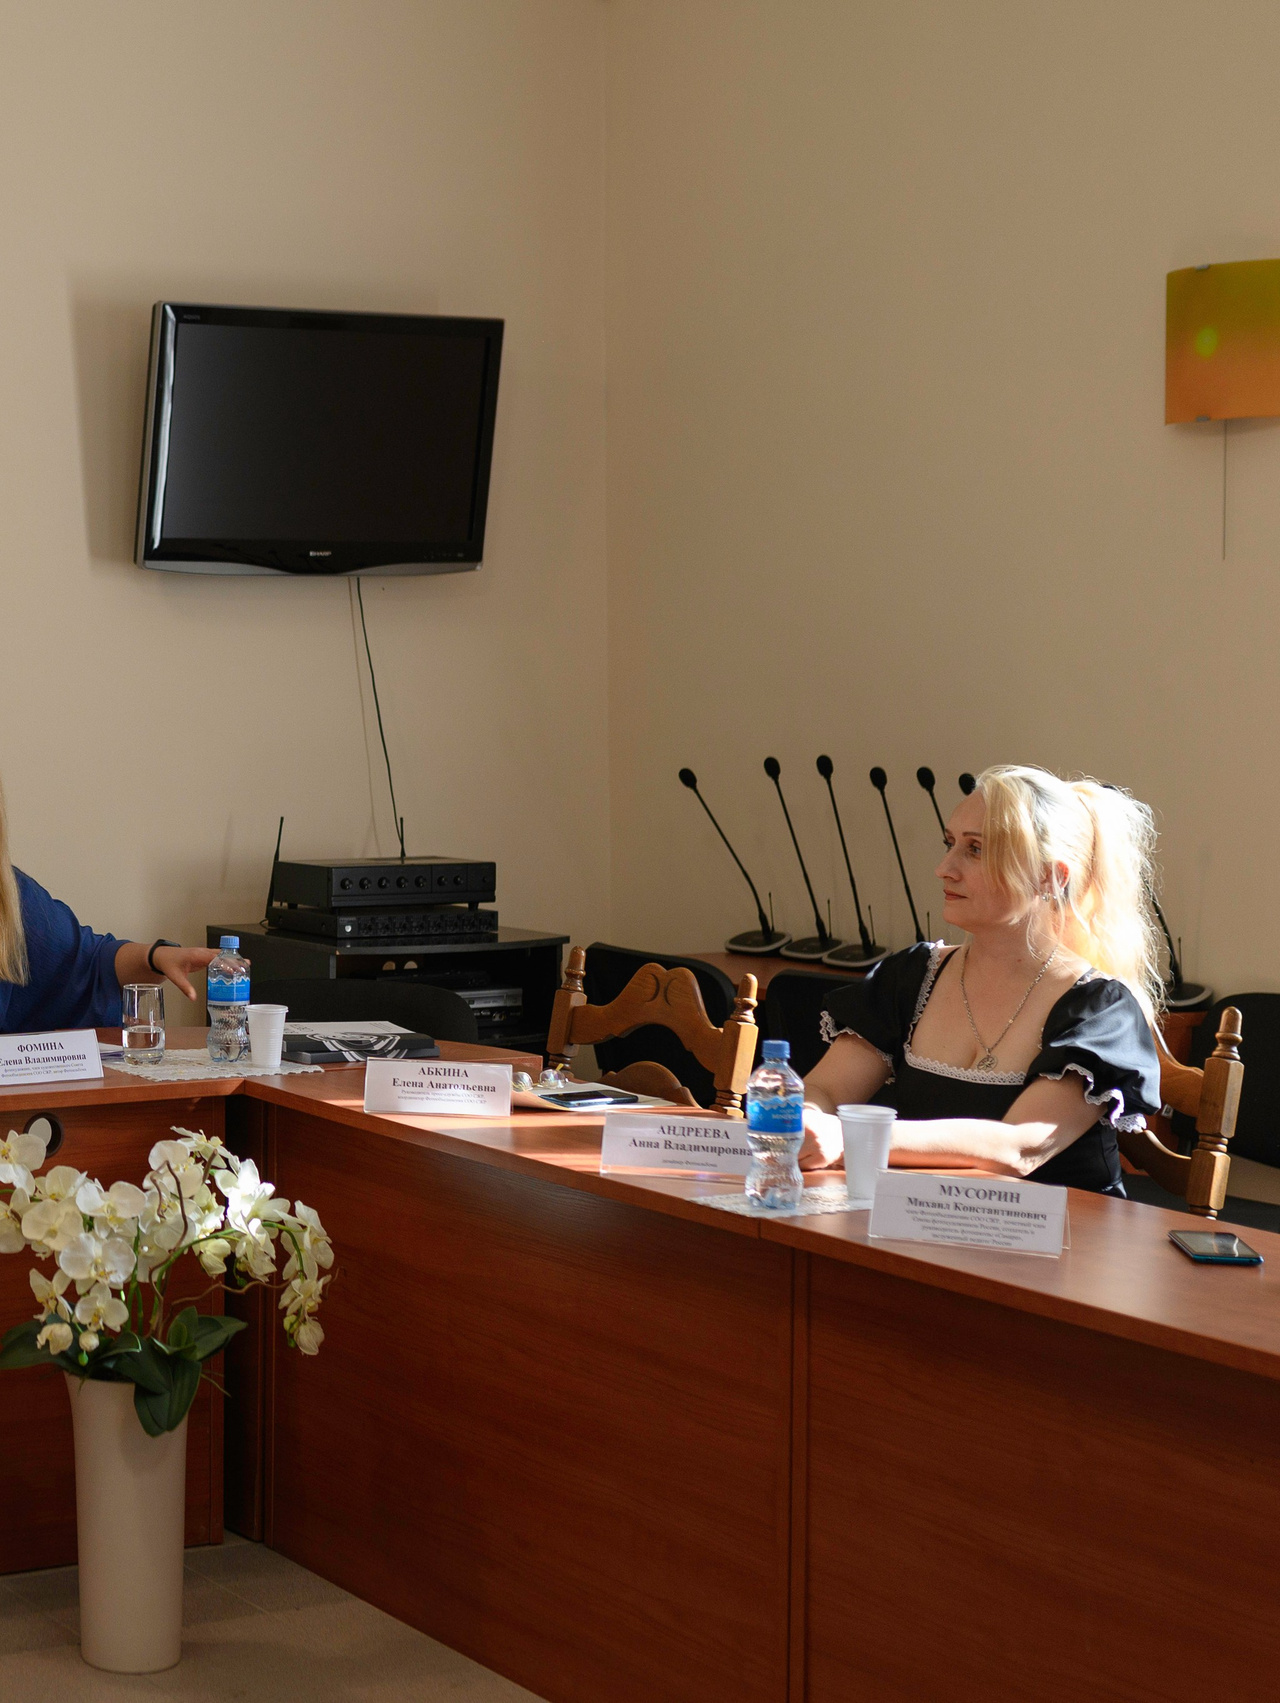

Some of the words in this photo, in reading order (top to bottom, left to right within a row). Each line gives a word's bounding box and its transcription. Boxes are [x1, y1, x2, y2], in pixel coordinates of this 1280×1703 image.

[17, 1042, 64, 1053] ФОМИНА
[24, 1053, 87, 1065] Владимировна
[418, 1066, 469, 1078] АБКИНА
[392, 1078, 424, 1088] Елена
[426, 1080, 496, 1093] Анатольевна
[657, 1124, 730, 1140] АНДРЕЕВА
[629, 1138, 660, 1149] Анна
[664, 1140, 753, 1157] Владимировна
[939, 1184, 1022, 1204] МУСОРИН
[907, 1197, 951, 1211] Михаил
[953, 1203, 1048, 1222] Константинович
